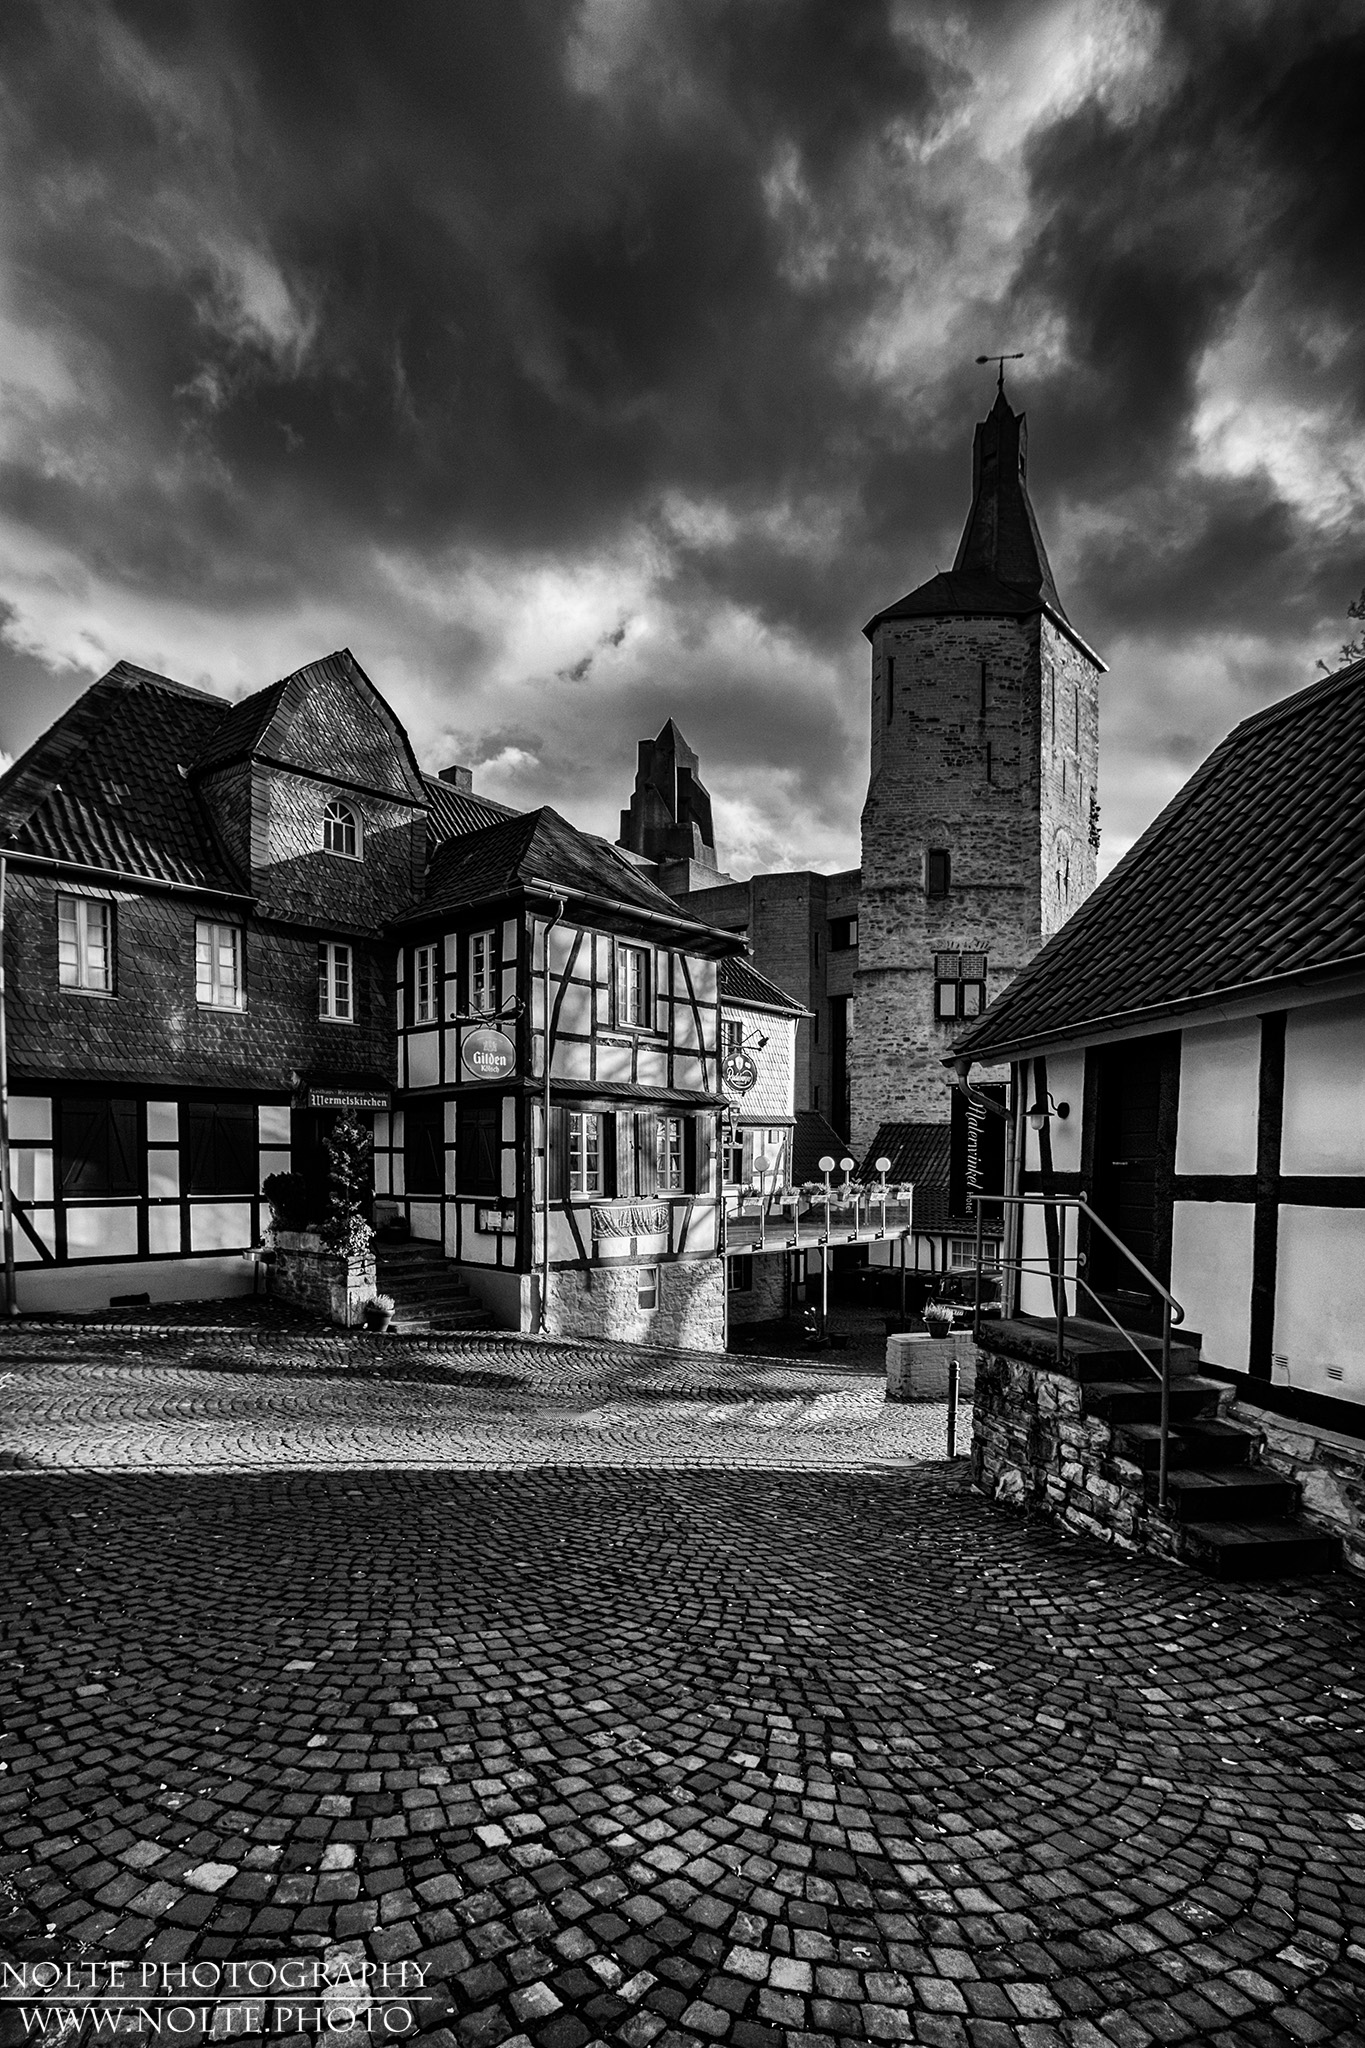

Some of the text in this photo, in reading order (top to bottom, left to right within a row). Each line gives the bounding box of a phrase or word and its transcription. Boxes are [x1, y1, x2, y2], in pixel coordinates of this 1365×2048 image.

[473, 1051, 507, 1066] Gilden
[481, 1065, 500, 1073] Kölsch
[311, 1094, 387, 1107] Wermelskirchen
[965, 1097, 987, 1189] Malerwinkel
[965, 1191, 974, 1214] Hotel
